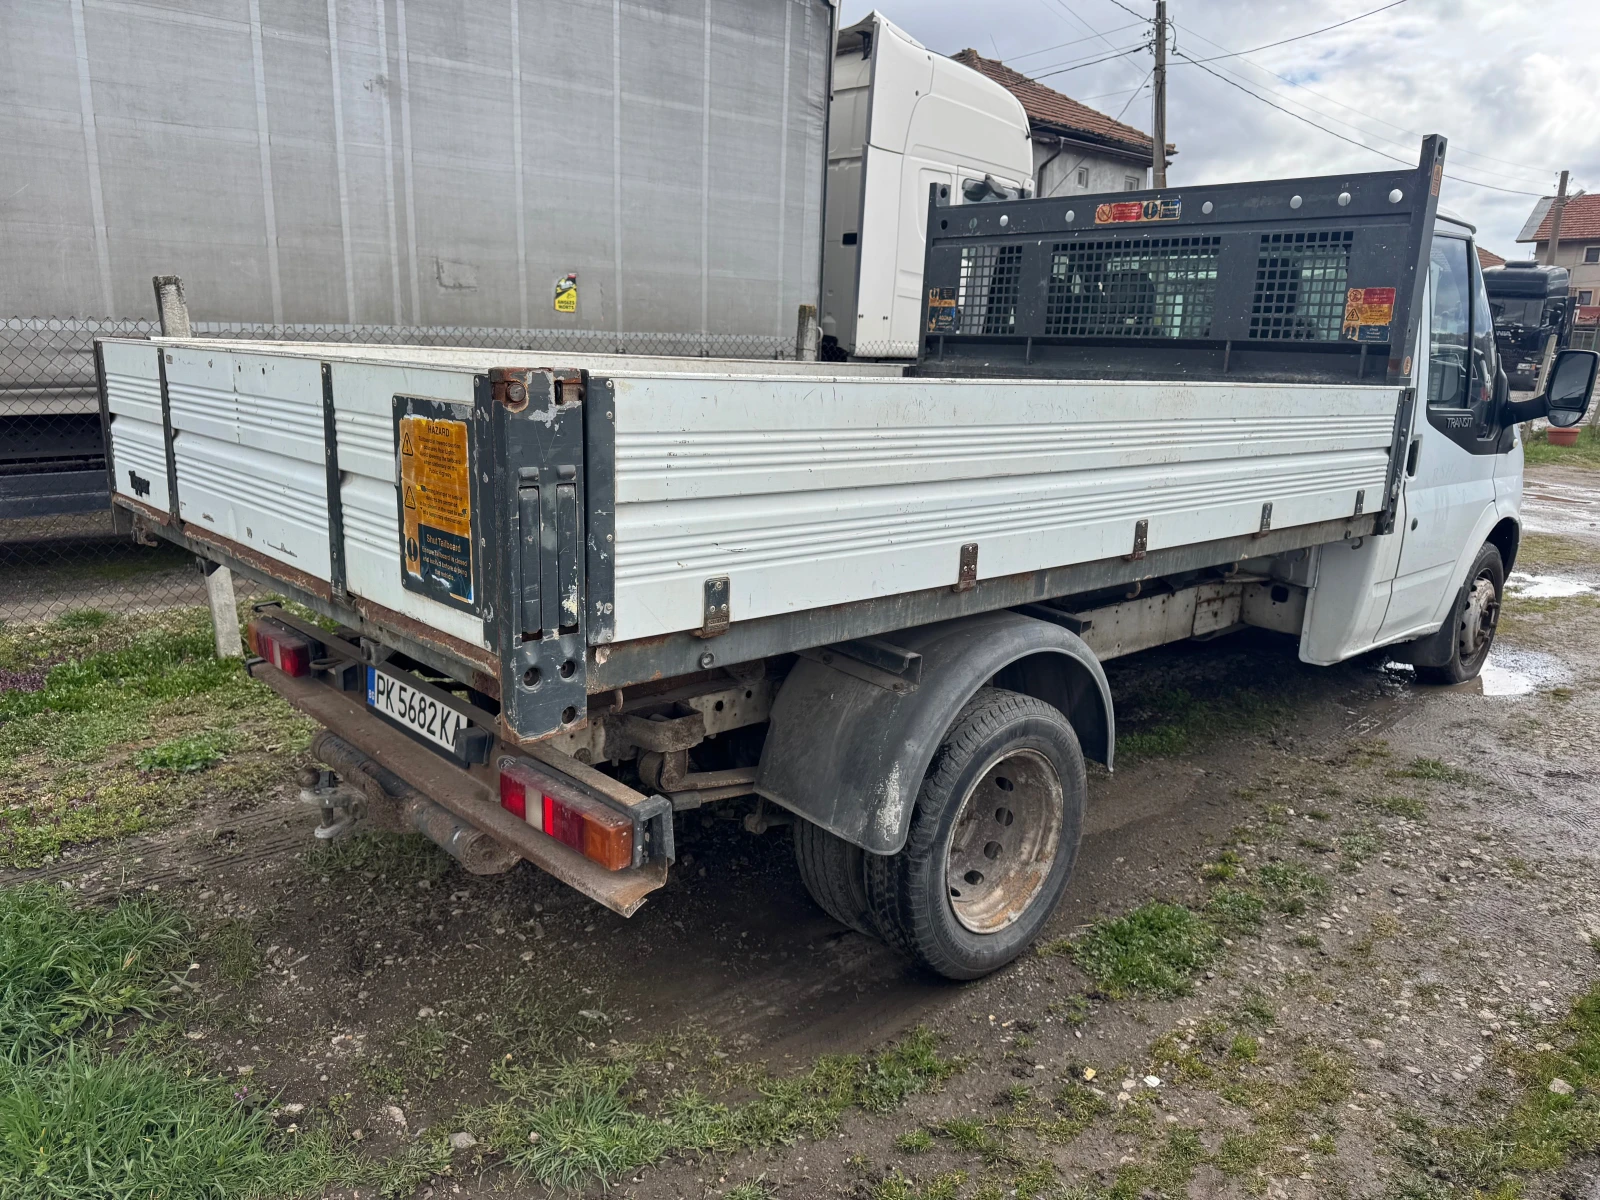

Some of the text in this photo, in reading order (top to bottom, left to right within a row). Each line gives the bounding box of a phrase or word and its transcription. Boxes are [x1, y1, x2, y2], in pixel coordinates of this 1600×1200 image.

[1447, 418, 1473, 428] TRANSIT
[428, 425, 450, 437] HAZARD
[427, 534, 461, 552] Shut Tailboard
